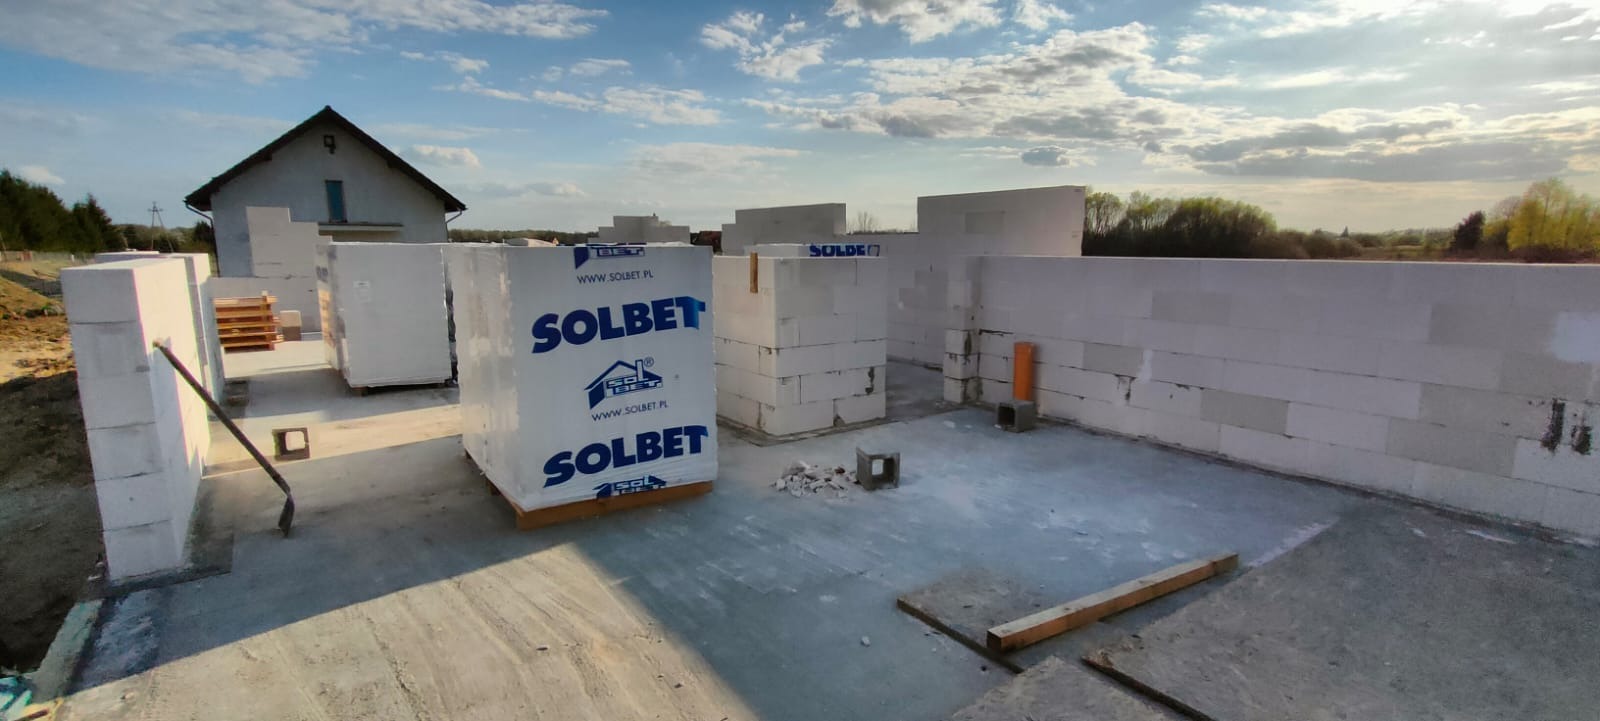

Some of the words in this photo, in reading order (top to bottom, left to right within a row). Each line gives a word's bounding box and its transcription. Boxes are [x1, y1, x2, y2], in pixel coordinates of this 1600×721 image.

[577, 269, 654, 285] WWW.SOLBET.PL
[531, 296, 706, 354] SOLBET
[591, 400, 669, 422] WWW.SOLBET.PL
[543, 425, 709, 488] SOLBET
